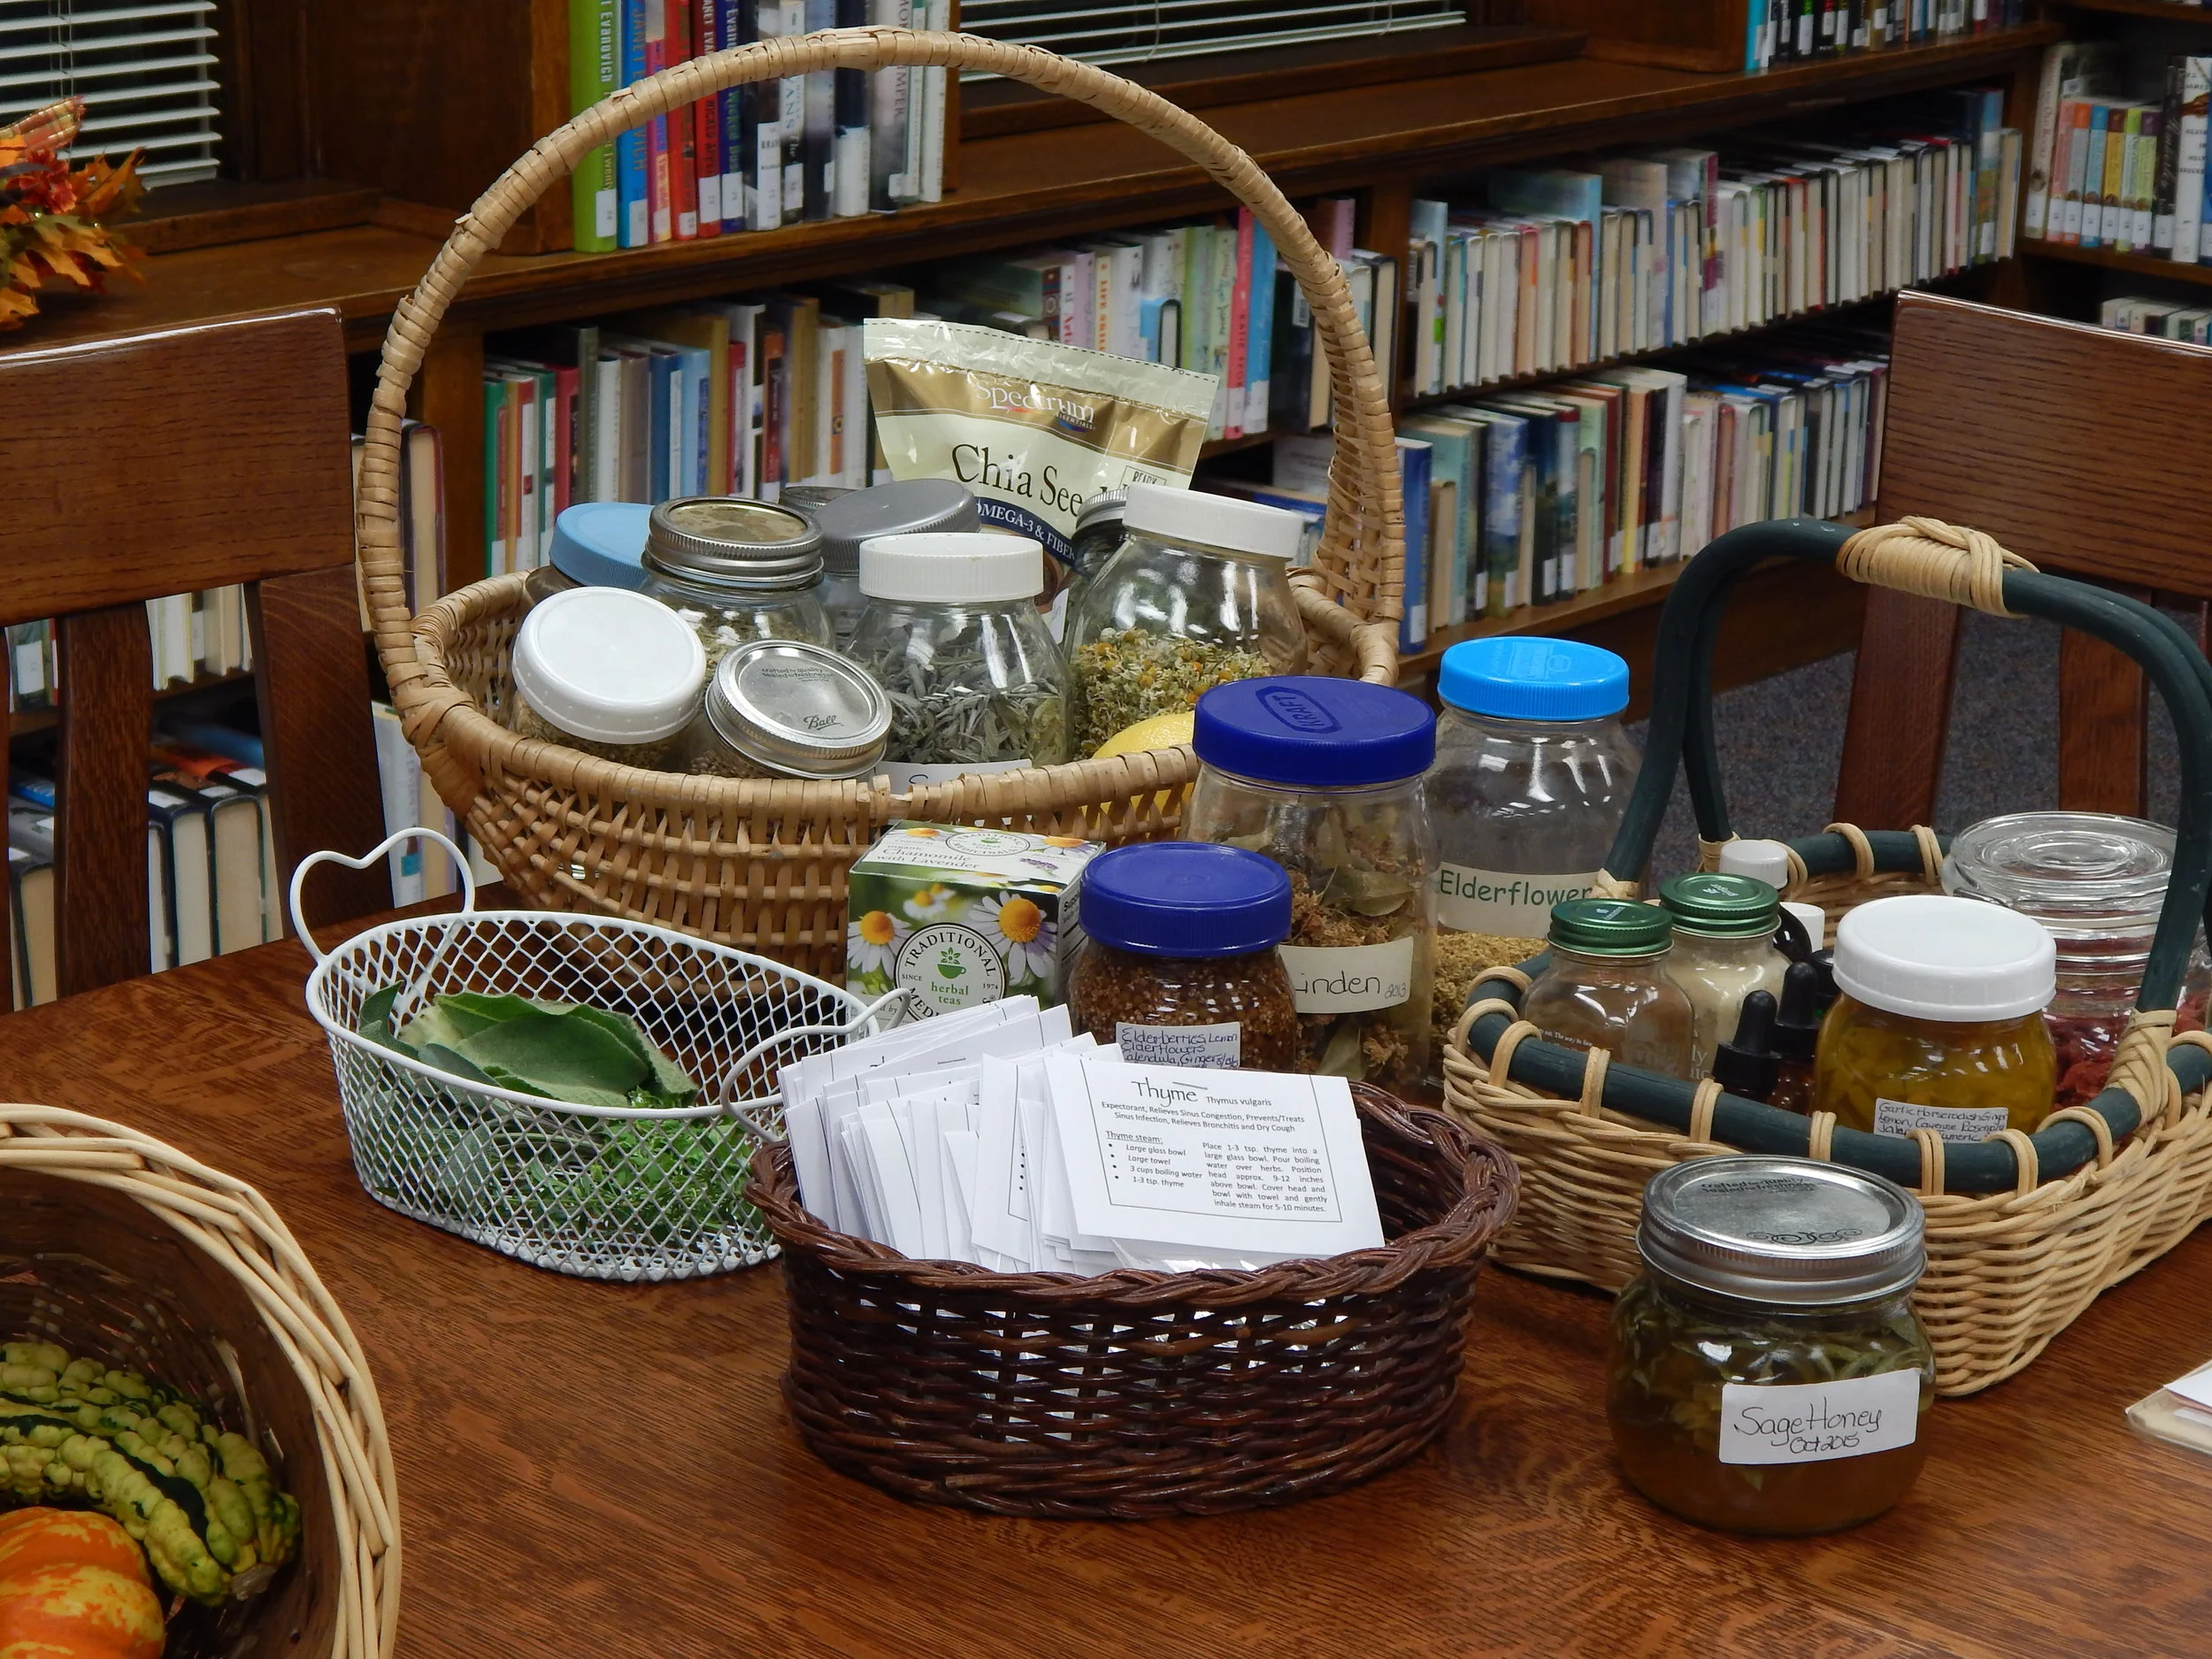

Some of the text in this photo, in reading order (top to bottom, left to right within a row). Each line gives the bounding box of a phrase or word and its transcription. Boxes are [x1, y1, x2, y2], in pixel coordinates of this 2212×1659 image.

[632, 8, 647, 63] JANET
[601, 11, 612, 82] Evanovich
[976, 380, 1095, 423] Spectrum
[952, 443, 1108, 518] Chia See
[1035, 524, 1045, 541] &
[1272, 695, 1325, 727] KRAFT
[803, 715, 839, 730] Ball
[883, 849, 972, 862] Chamomile
[911, 856, 980, 869] Lavender
[904, 932, 996, 977] TRADITIONAL
[931, 981, 969, 995] herbal
[1295, 971, 1408, 999] inden 2013
[939, 996, 962, 1005] teas
[1131, 1077, 1272, 1107] Thyme Thymus vulgaris
[1102, 1102, 1148, 1113] Expectorant,
[1150, 1106, 1179, 1116] Relieves
[1201, 1111, 1245, 1121] Congestion,
[1246, 1114, 1305, 1123] Prevents/Treats
[1879, 1102, 1915, 1115] Garlic
[1115, 1111, 1134, 1120] Sinus
[1136, 1113, 1170, 1125] Infection,
[1171, 1118, 1202, 1127] Relieves
[1203, 1120, 1240, 1130] Bronchitis
[1256, 1124, 1270, 1133] Dry
[1271, 1125, 1295, 1133] Cough
[1105, 1131, 1164, 1144] Thyme steam:
[1126, 1144, 1147, 1154] Large
[1168, 1148, 1187, 1156] bowl
[1128, 1155, 1171, 1165] Large towel
[1204, 1151, 1223, 1160] large
[1248, 1154, 1269, 1163] bowl.
[1294, 1156, 1320, 1165] boiling
[1155, 1168, 1179, 1178] boiling
[1236, 1173, 1263, 1182] approx.
[1272, 1174, 1291, 1183] 9-12
[1161, 1179, 1185, 1188] thyme
[1214, 1199, 1237, 1208] inhale
[1790, 1432, 1860, 1454] Oct 2015
